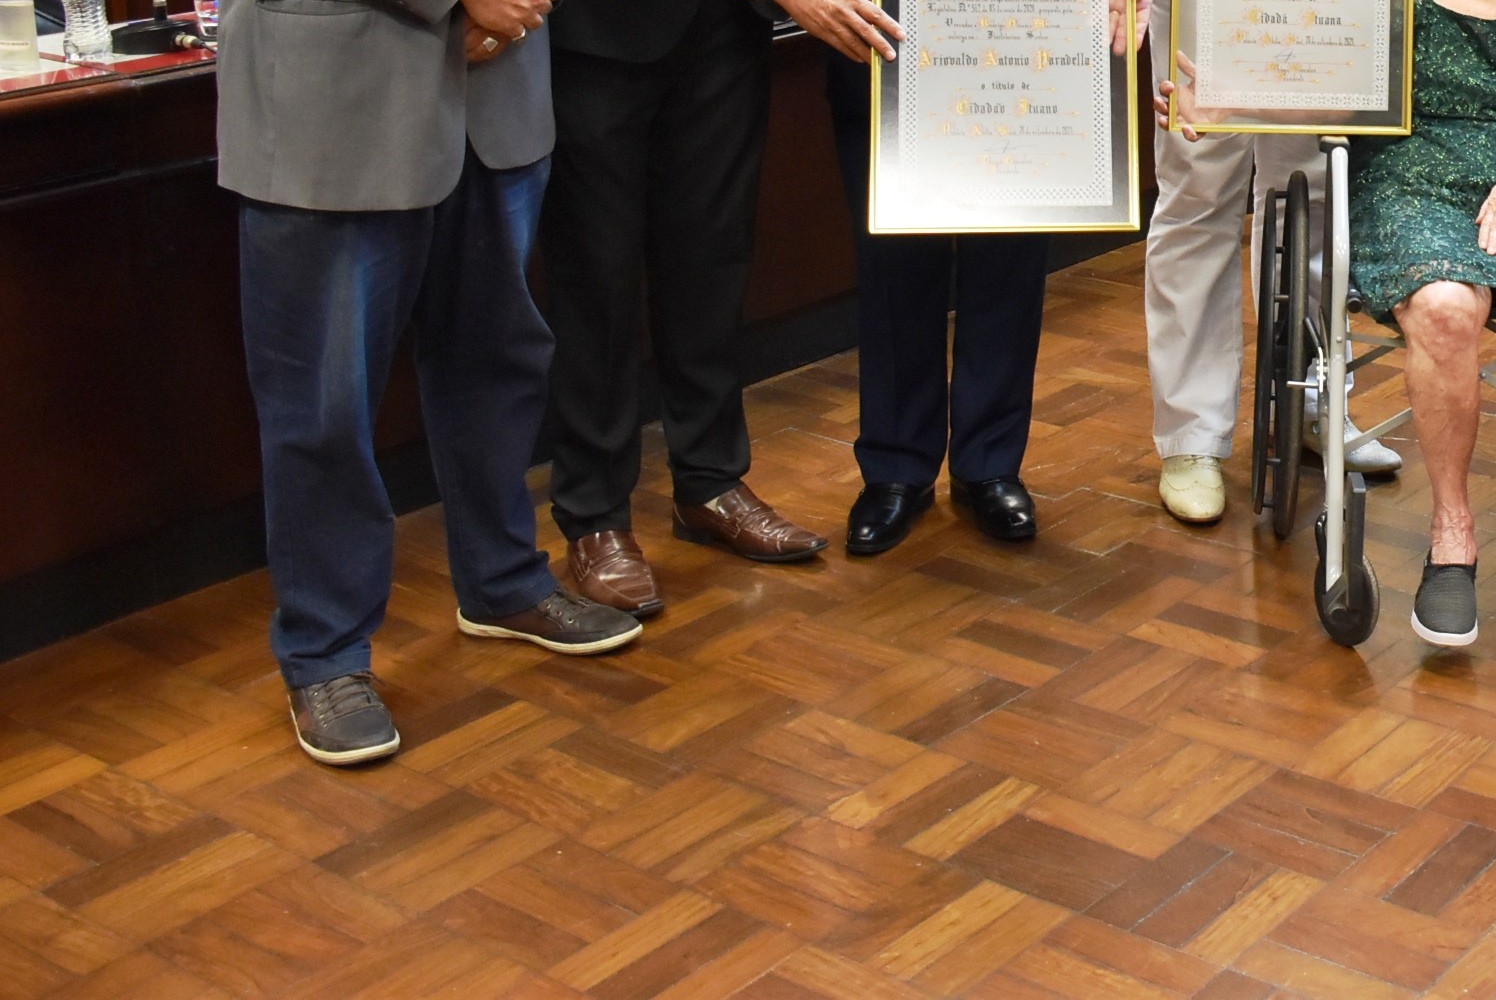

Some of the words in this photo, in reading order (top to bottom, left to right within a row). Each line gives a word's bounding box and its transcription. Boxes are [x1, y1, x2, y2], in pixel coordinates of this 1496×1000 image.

[919, 50, 978, 67] Ariovaldo
[984, 50, 1030, 67] Antonio
[957, 99, 1005, 115] Cidadão
[1018, 99, 1058, 115] Ituano
